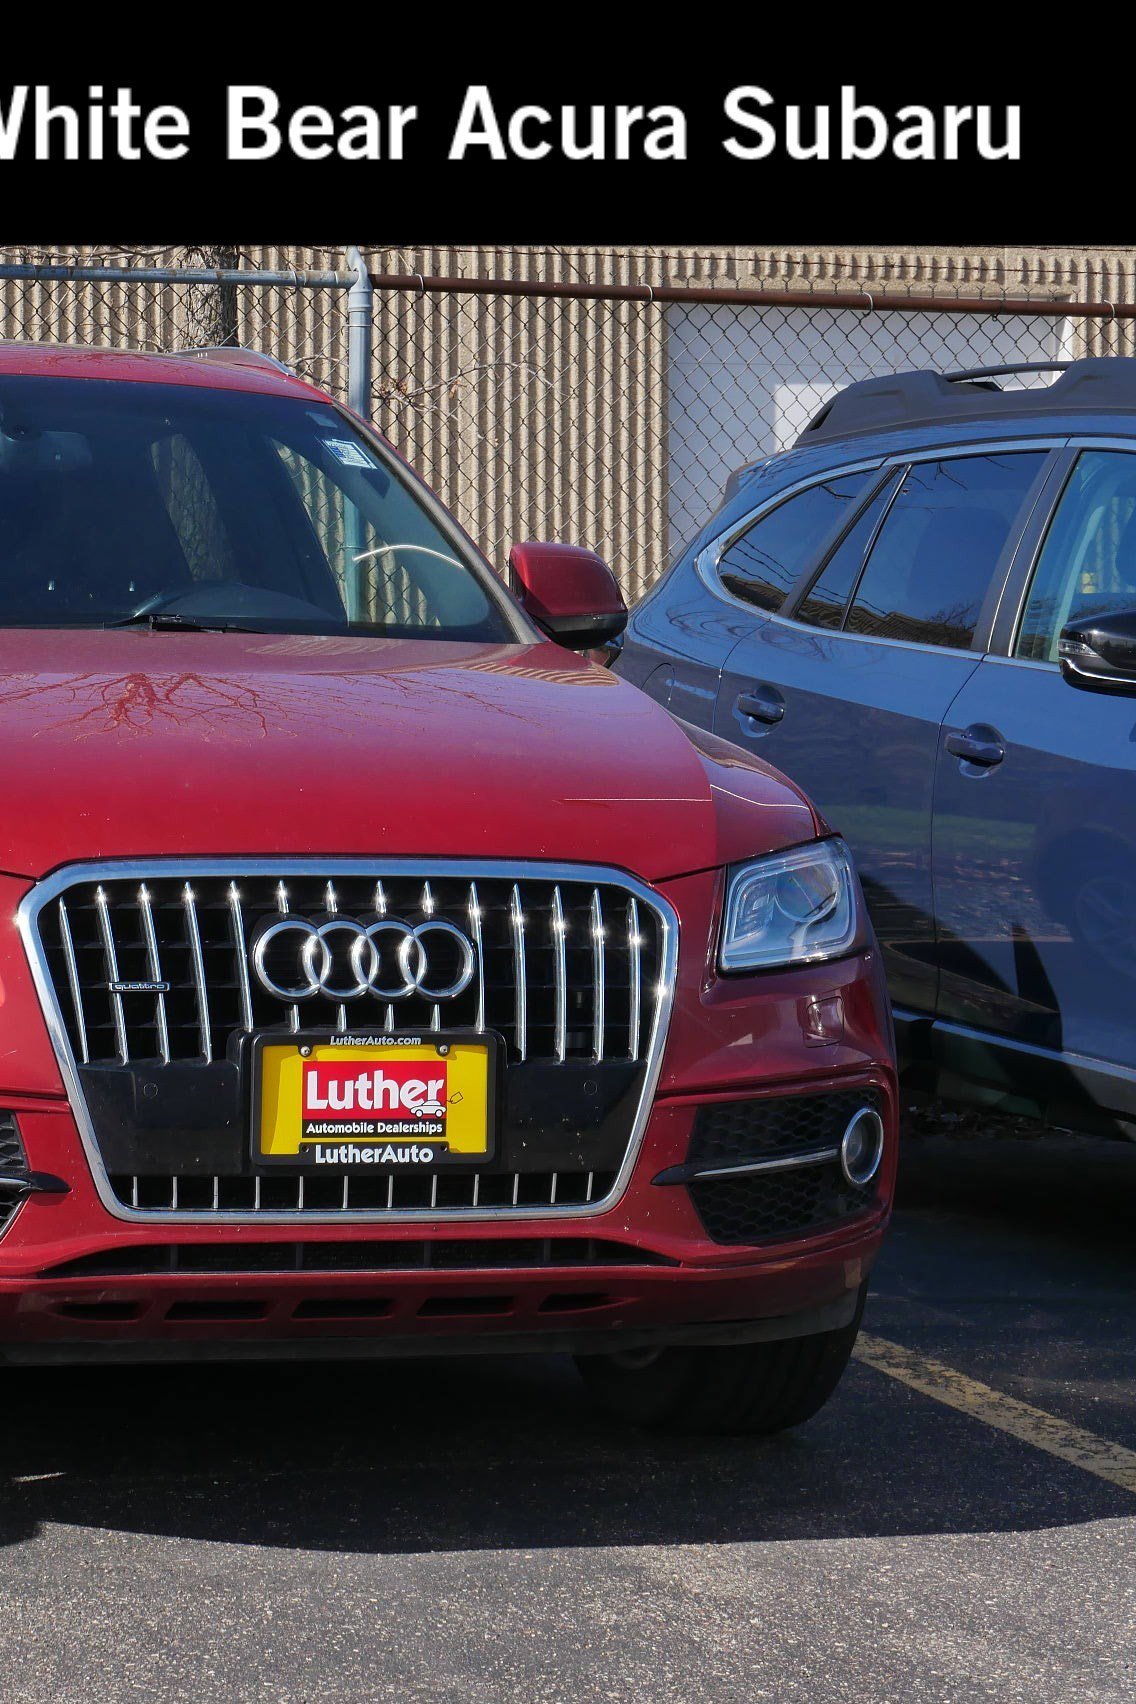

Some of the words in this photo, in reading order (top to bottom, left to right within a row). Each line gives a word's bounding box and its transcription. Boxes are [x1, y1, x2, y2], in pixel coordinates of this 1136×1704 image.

[114, 983, 165, 991] quattro
[330, 1035, 421, 1046] LutherAuto.com
[306, 1069, 445, 1110] Luther
[306, 1122, 374, 1134] Automobile
[377, 1122, 443, 1135] Dealerships
[315, 1144, 434, 1164] LutherAuto
